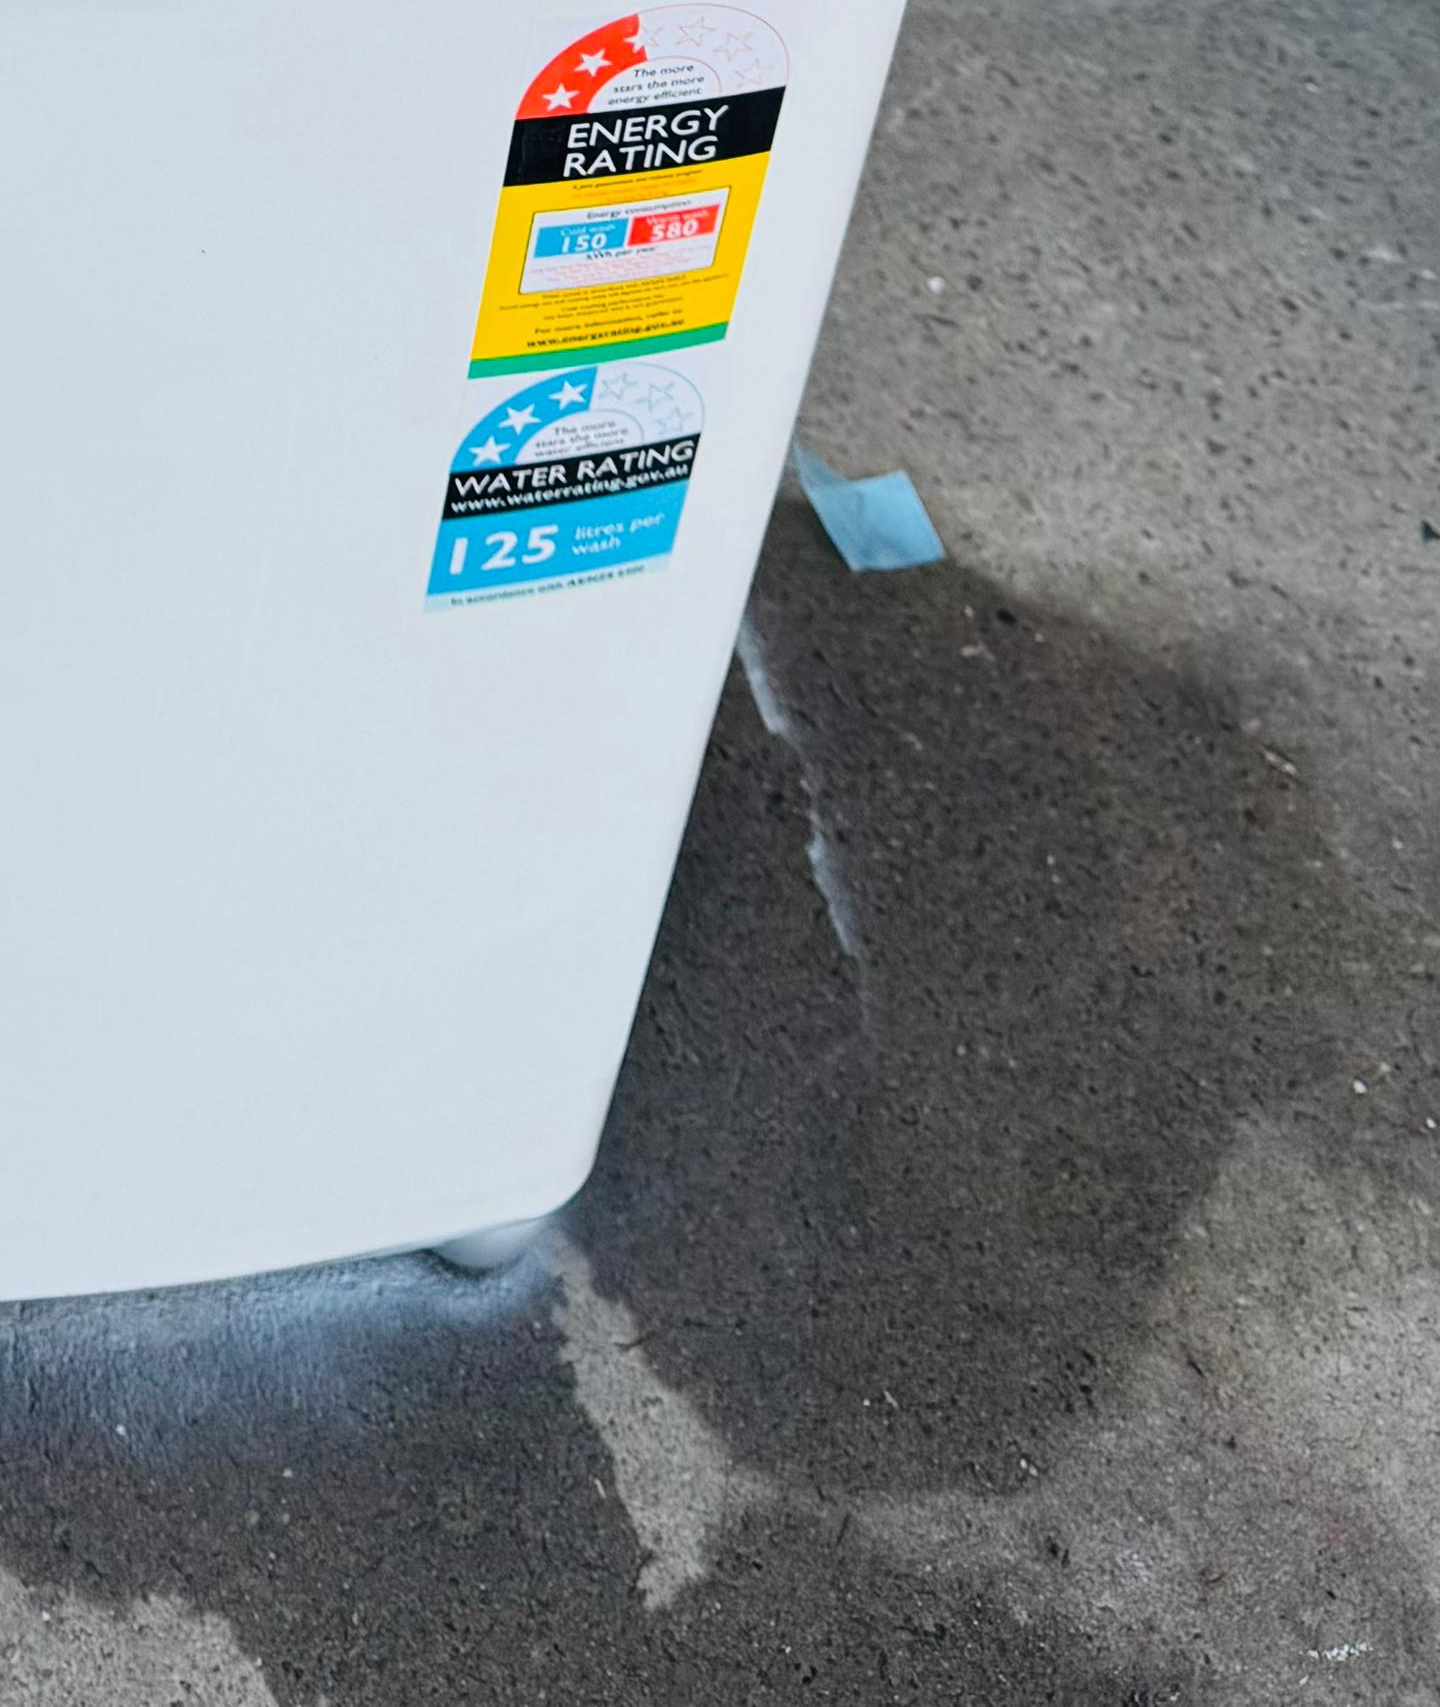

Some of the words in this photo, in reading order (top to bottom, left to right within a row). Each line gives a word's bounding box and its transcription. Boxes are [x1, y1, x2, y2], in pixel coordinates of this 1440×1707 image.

[633, 69, 657, 78] The
[660, 64, 695, 75] more
[607, 95, 650, 106] energy
[653, 87, 703, 100] efficient
[613, 84, 643, 93] stars
[647, 80, 667, 90] the
[671, 76, 705, 87] more
[566, 103, 729, 149] ENERGY
[562, 134, 719, 178] RATING
[649, 218, 700, 243] 580
[561, 232, 608, 255] 150
[454, 463, 569, 497] WATER
[576, 439, 696, 481] RATING
[574, 521, 625, 541] litres
[629, 512, 666, 534] per
[449, 523, 560, 576] 125
[571, 534, 622, 556] wash
